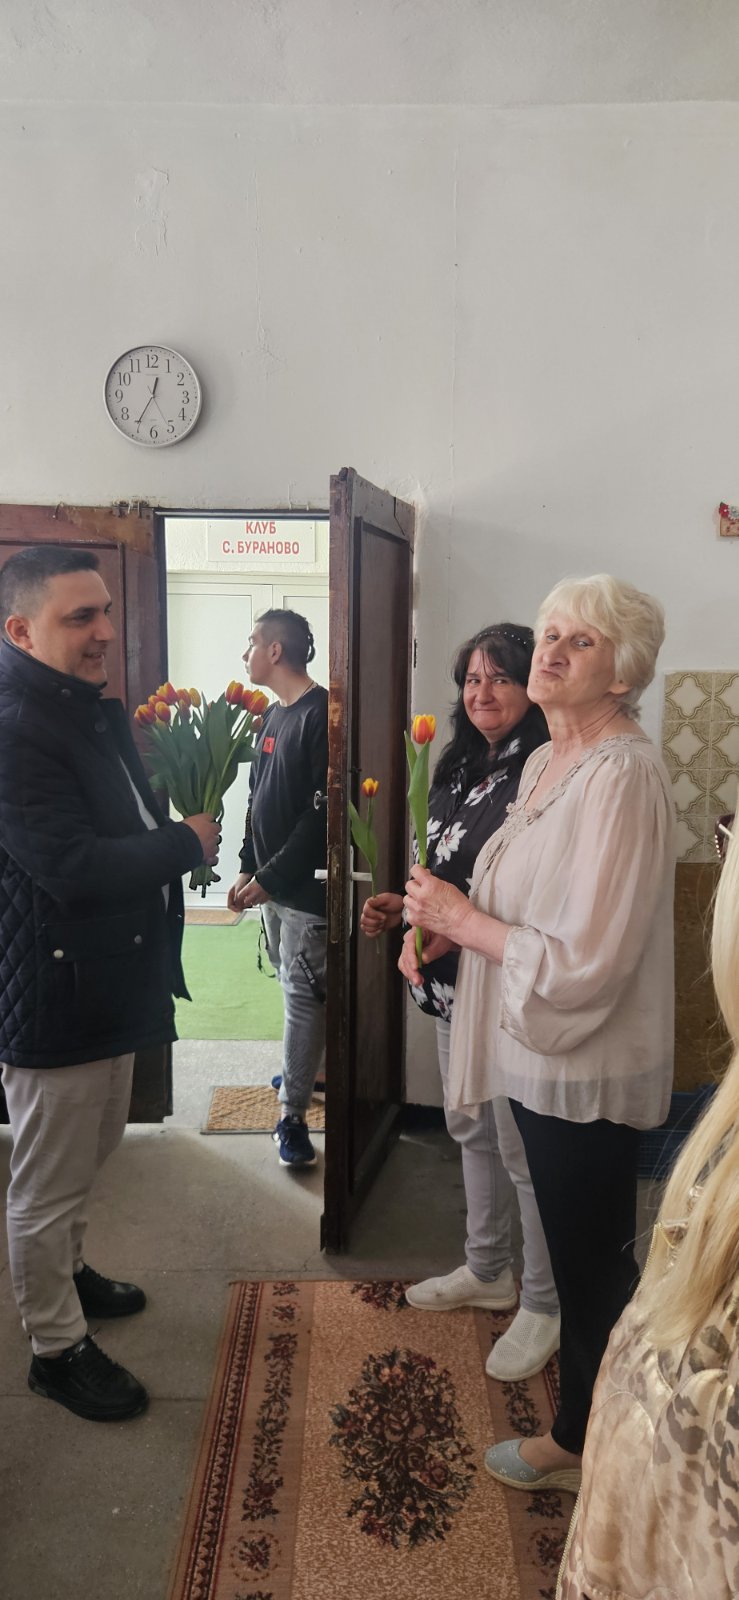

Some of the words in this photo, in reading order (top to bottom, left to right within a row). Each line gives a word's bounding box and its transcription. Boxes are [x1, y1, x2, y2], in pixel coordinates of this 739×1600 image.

[129, 359, 141, 373] 11
[145, 354, 159, 368] 12
[118, 372, 131, 386] 10
[177, 372, 185, 386] 2
[115, 389, 123, 403] 9
[182, 391, 189, 404] 3
[121, 407, 129, 420] 8
[178, 407, 186, 421] 4
[150, 425, 158, 439] 6
[167, 420, 175, 433] 5
[246, 521, 276, 534] КЛУБ
[222, 541, 235, 554] С.
[237, 541, 300, 555] БУРАНОВО
